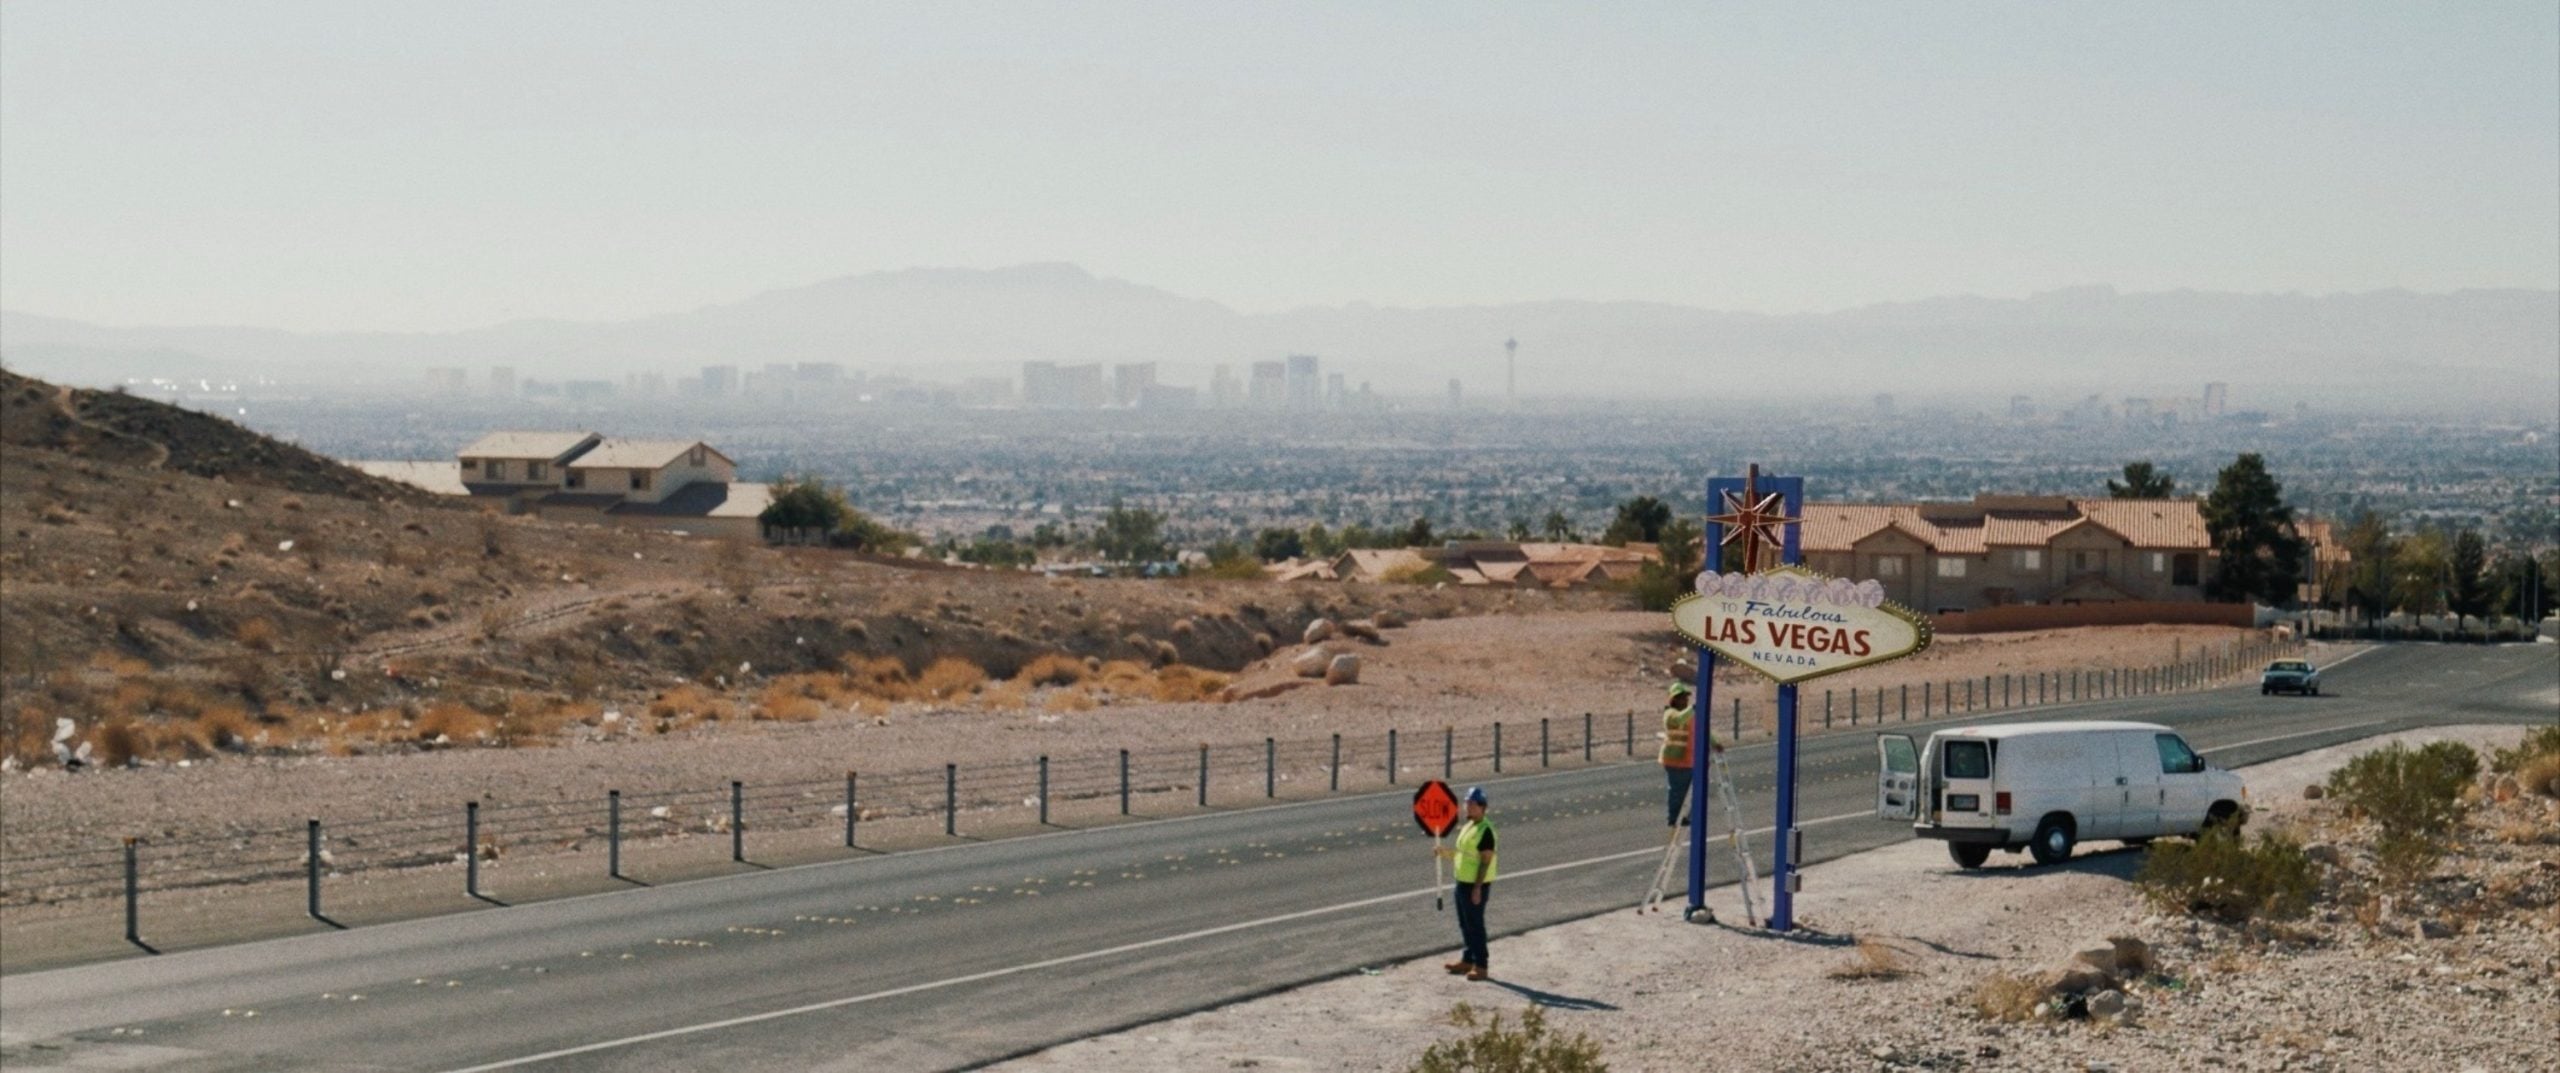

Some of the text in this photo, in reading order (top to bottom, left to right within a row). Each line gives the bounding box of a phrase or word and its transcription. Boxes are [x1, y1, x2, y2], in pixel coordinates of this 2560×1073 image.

[1721, 601, 1848, 623] TO Fabulous
[1705, 616, 1871, 657] LAS VEGAS
[1753, 651, 1816, 667] NEVADA
